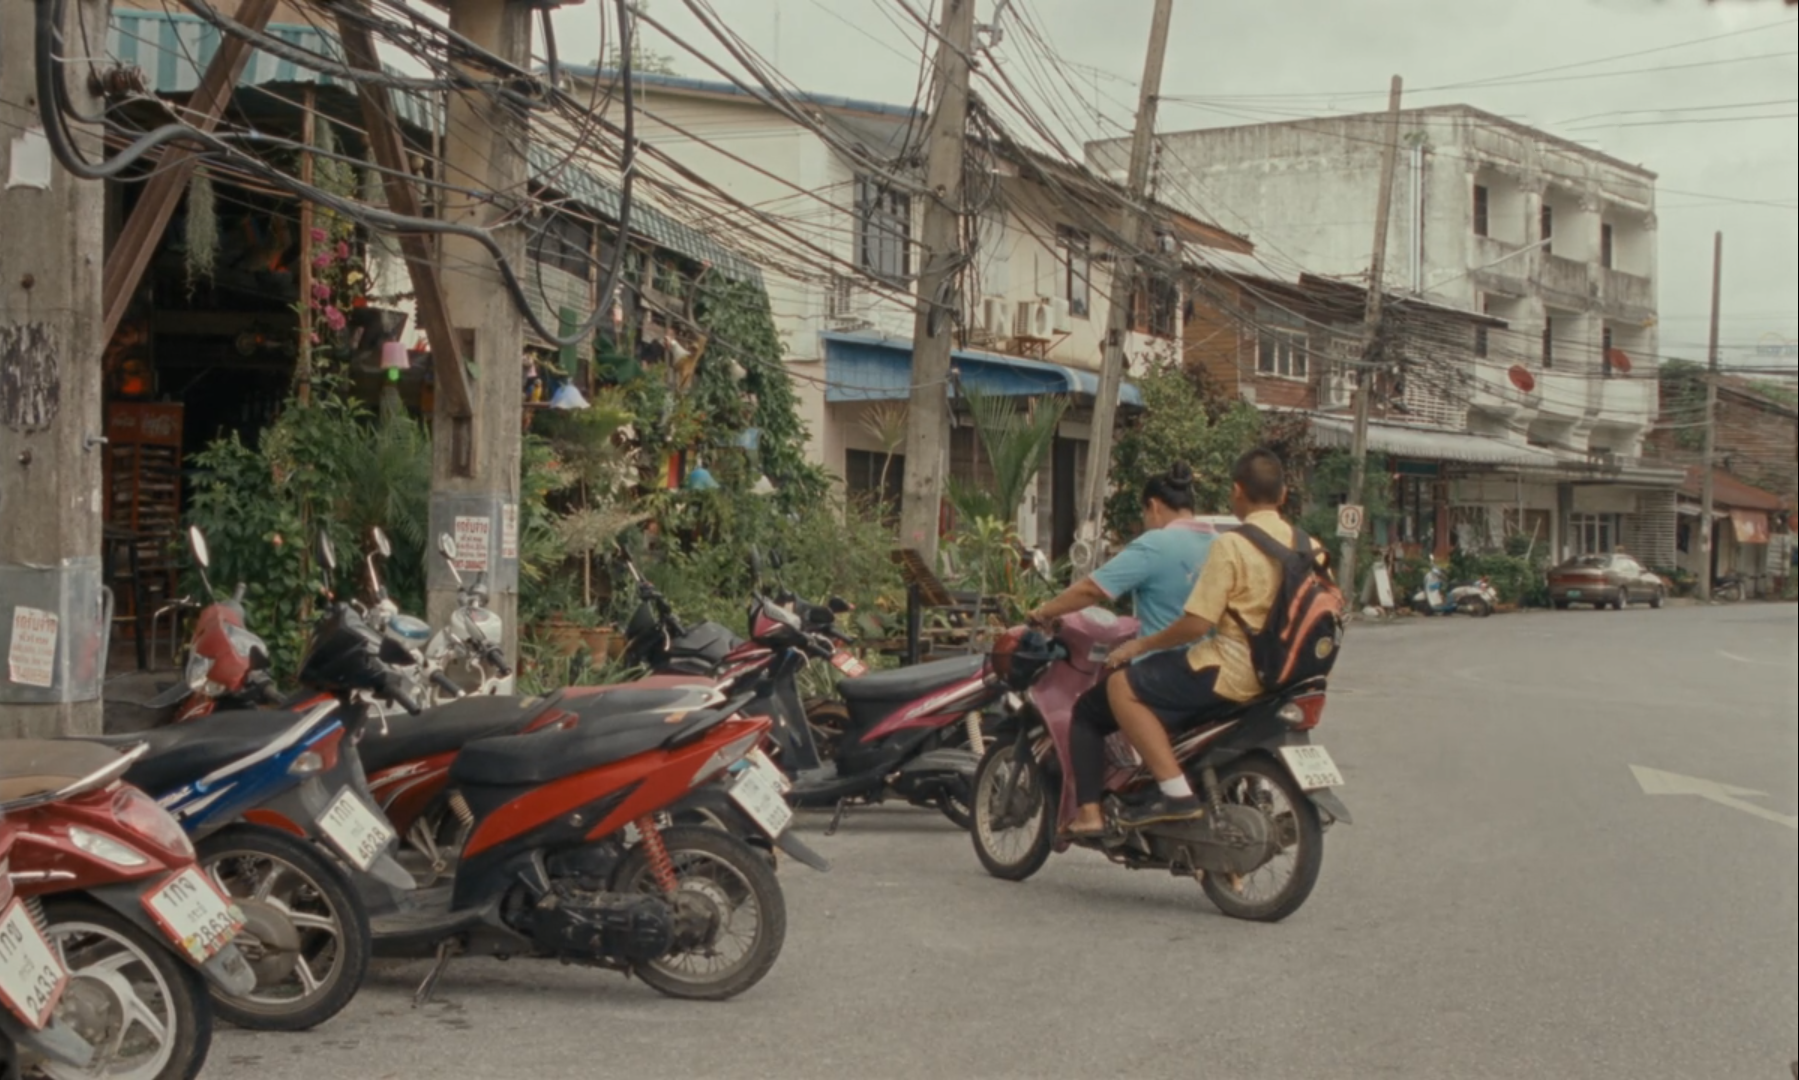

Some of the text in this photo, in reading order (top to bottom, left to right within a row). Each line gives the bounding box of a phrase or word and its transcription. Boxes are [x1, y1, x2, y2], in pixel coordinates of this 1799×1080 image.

[15, 611, 57, 634] รถรับจ้าง
[357, 826, 387, 860] 4628
[162, 876, 197, 908] 1กจ
[25, 964, 59, 1015] 2433
